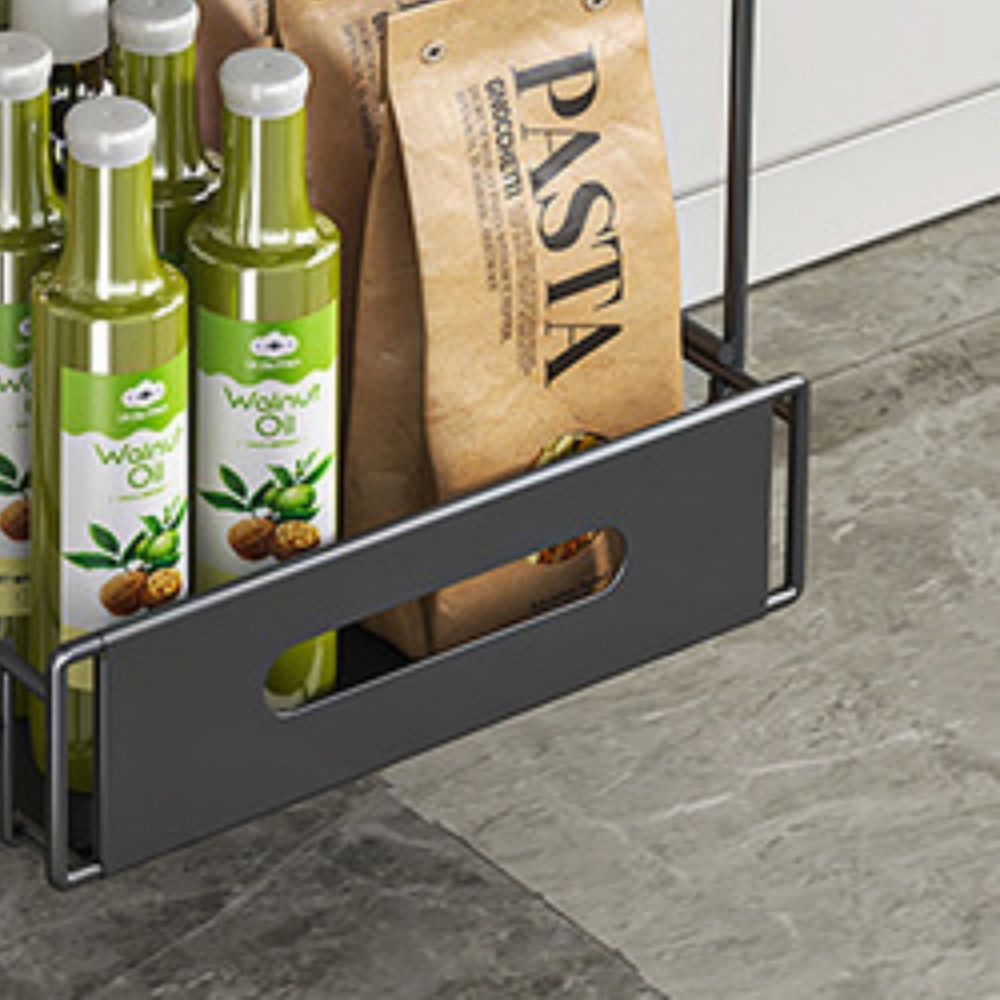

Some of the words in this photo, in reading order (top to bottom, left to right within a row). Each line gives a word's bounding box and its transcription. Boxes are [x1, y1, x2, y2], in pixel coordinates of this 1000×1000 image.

[511, 46, 624, 387] PASTA
[222, 383, 321, 413] Walnut
[254, 412, 297, 438] Oil
